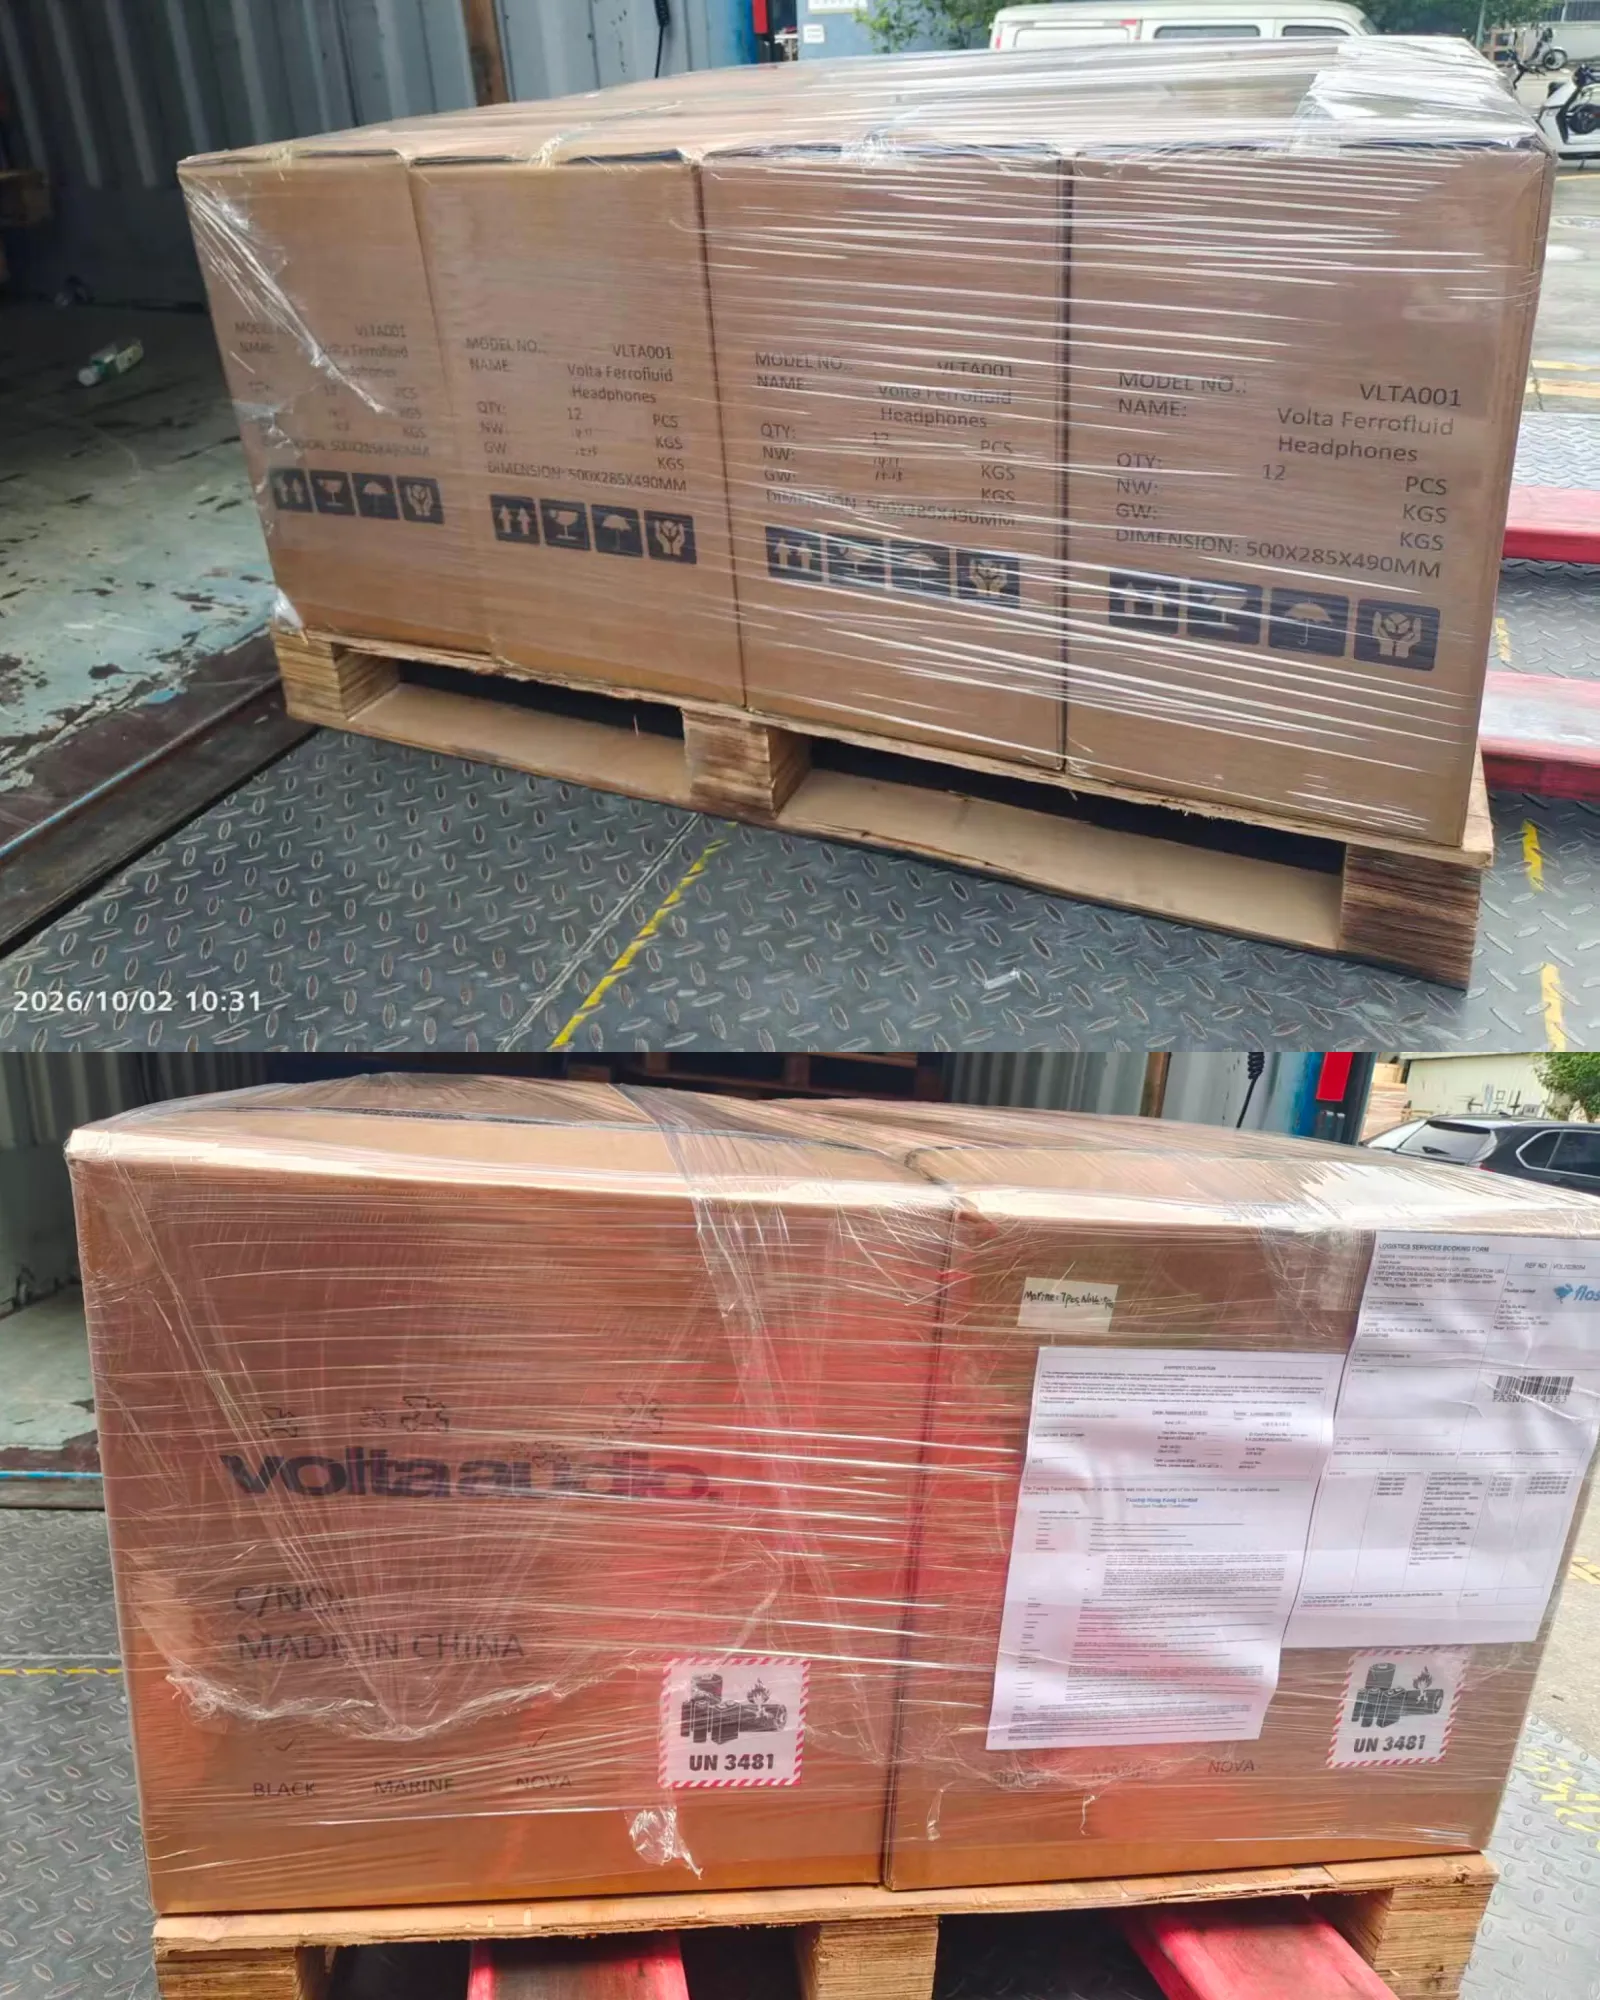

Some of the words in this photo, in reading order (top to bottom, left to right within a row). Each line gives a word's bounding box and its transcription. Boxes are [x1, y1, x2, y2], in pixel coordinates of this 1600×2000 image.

[465, 337, 515, 352] MODEL
[613, 344, 674, 359] VLTA001
[567, 363, 602, 378] Volta
[606, 364, 674, 382] Ferrofluid
[755, 352, 814, 369] MODEL
[571, 385, 657, 404] Headphones
[1118, 371, 1195, 391] MODEL
[1358, 383, 1462, 408] VLTA001
[567, 407, 583, 420] 12
[652, 413, 679, 428] PCS
[880, 407, 988, 428] Headphones
[1117, 397, 1188, 418] NAME:
[1277, 406, 1334, 428] Volta
[1341, 410, 1455, 436] Ferrofluid
[655, 436, 684, 450] KGS
[760, 422, 796, 440] QTY:
[980, 440, 1013, 455] PCS
[1278, 435, 1419, 463] Headphones
[657, 457, 685, 471] KGS
[763, 446, 796, 461] NW:
[980, 464, 1016, 482] KGS
[1116, 452, 1164, 470] QTY:
[1261, 463, 1287, 481] 12
[1404, 475, 1448, 496] PCS
[568, 467, 687, 492] 500X285X490MM
[764, 469, 796, 483] GW:
[980, 487, 1016, 504] KGS
[1116, 478, 1160, 496] NW:
[1402, 503, 1447, 524] KGS
[1115, 502, 1159, 520] GW:
[1399, 531, 1445, 551] KGS
[1115, 529, 1241, 556] DIMENSION:
[1245, 540, 1442, 580] 500X285X490MM
[237, 1634, 347, 1659] MADE
[363, 1632, 398, 1658] IN
[412, 1633, 524, 1658] CHINA
[1353, 1737, 1379, 1753] UN
[1382, 1734, 1426, 1752] 3481
[689, 1754, 718, 1771] UN
[724, 1753, 775, 1771] 3481
[1207, 1758, 1255, 1773] NOVA
[253, 1782, 316, 1797] BLACK
[374, 1778, 455, 1794] MARINE
[515, 1774, 573, 1790] NOVA
